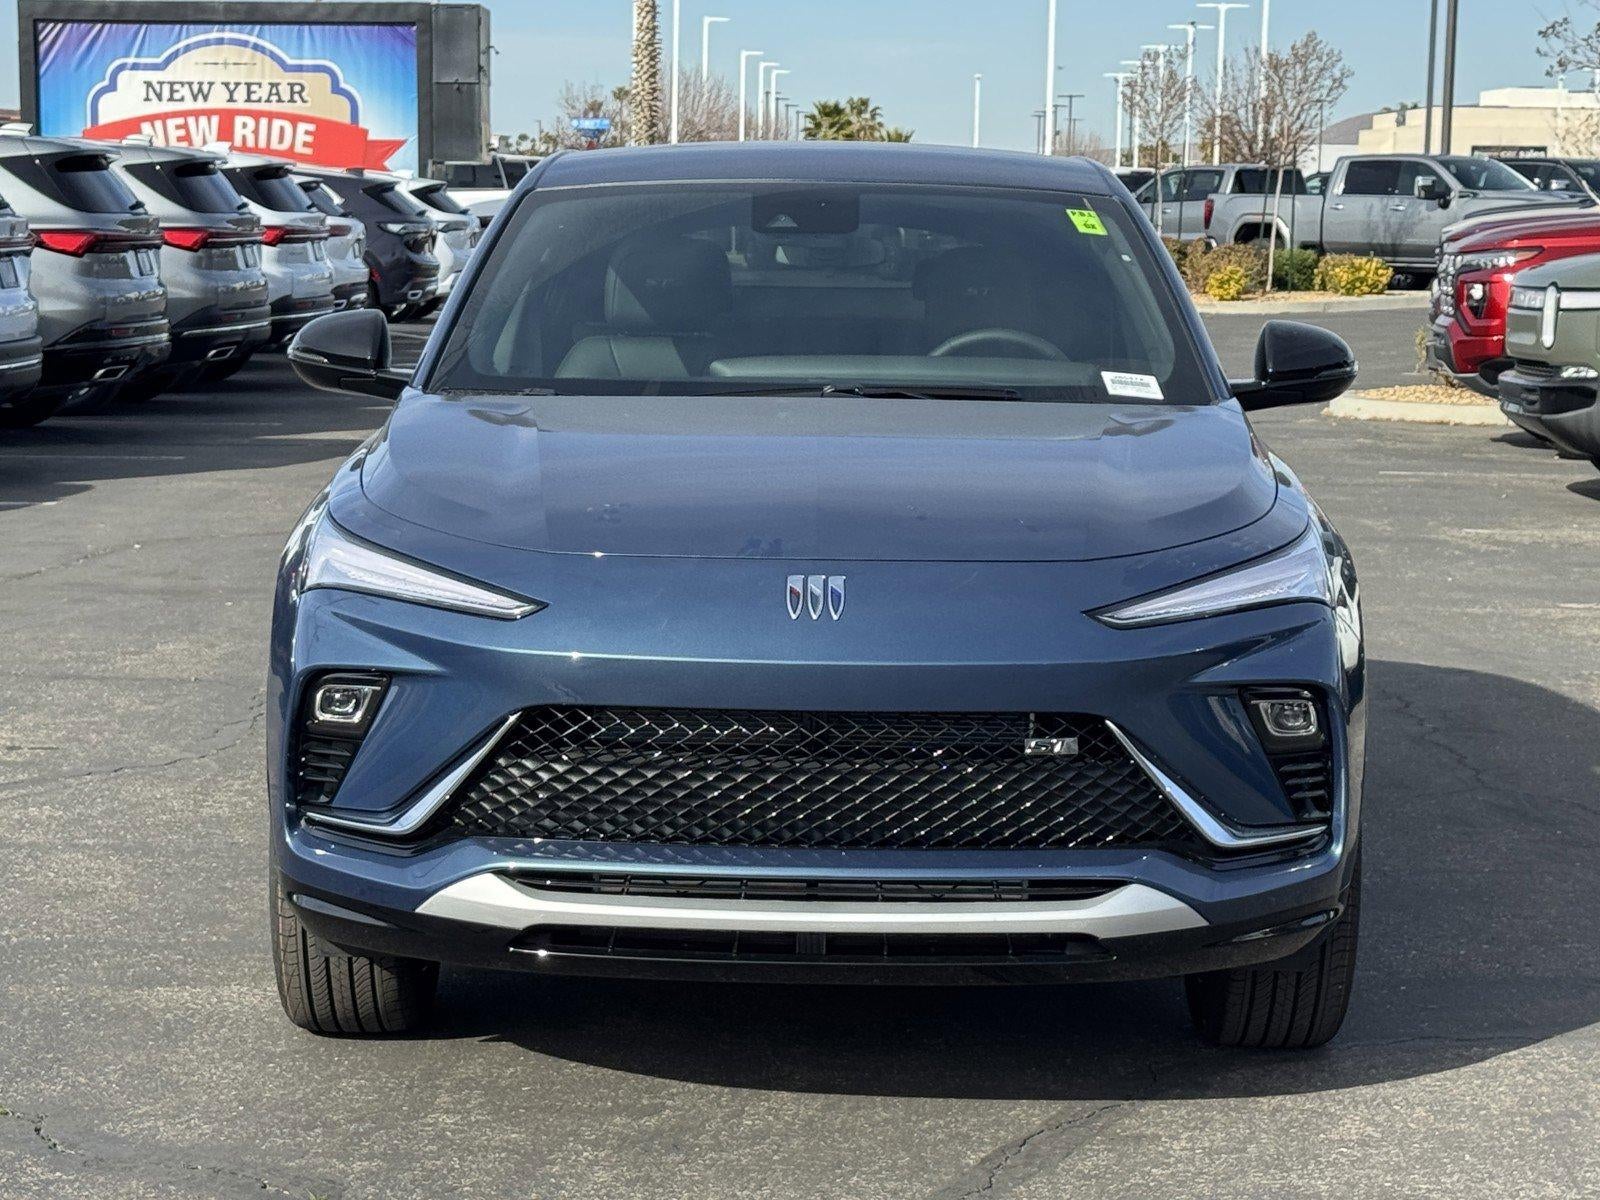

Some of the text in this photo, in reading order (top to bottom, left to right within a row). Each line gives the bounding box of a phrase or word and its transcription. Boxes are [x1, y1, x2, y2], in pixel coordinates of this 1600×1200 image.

[143, 80, 308, 104] NEW YEAR
[140, 114, 317, 155] NEW RIDE
